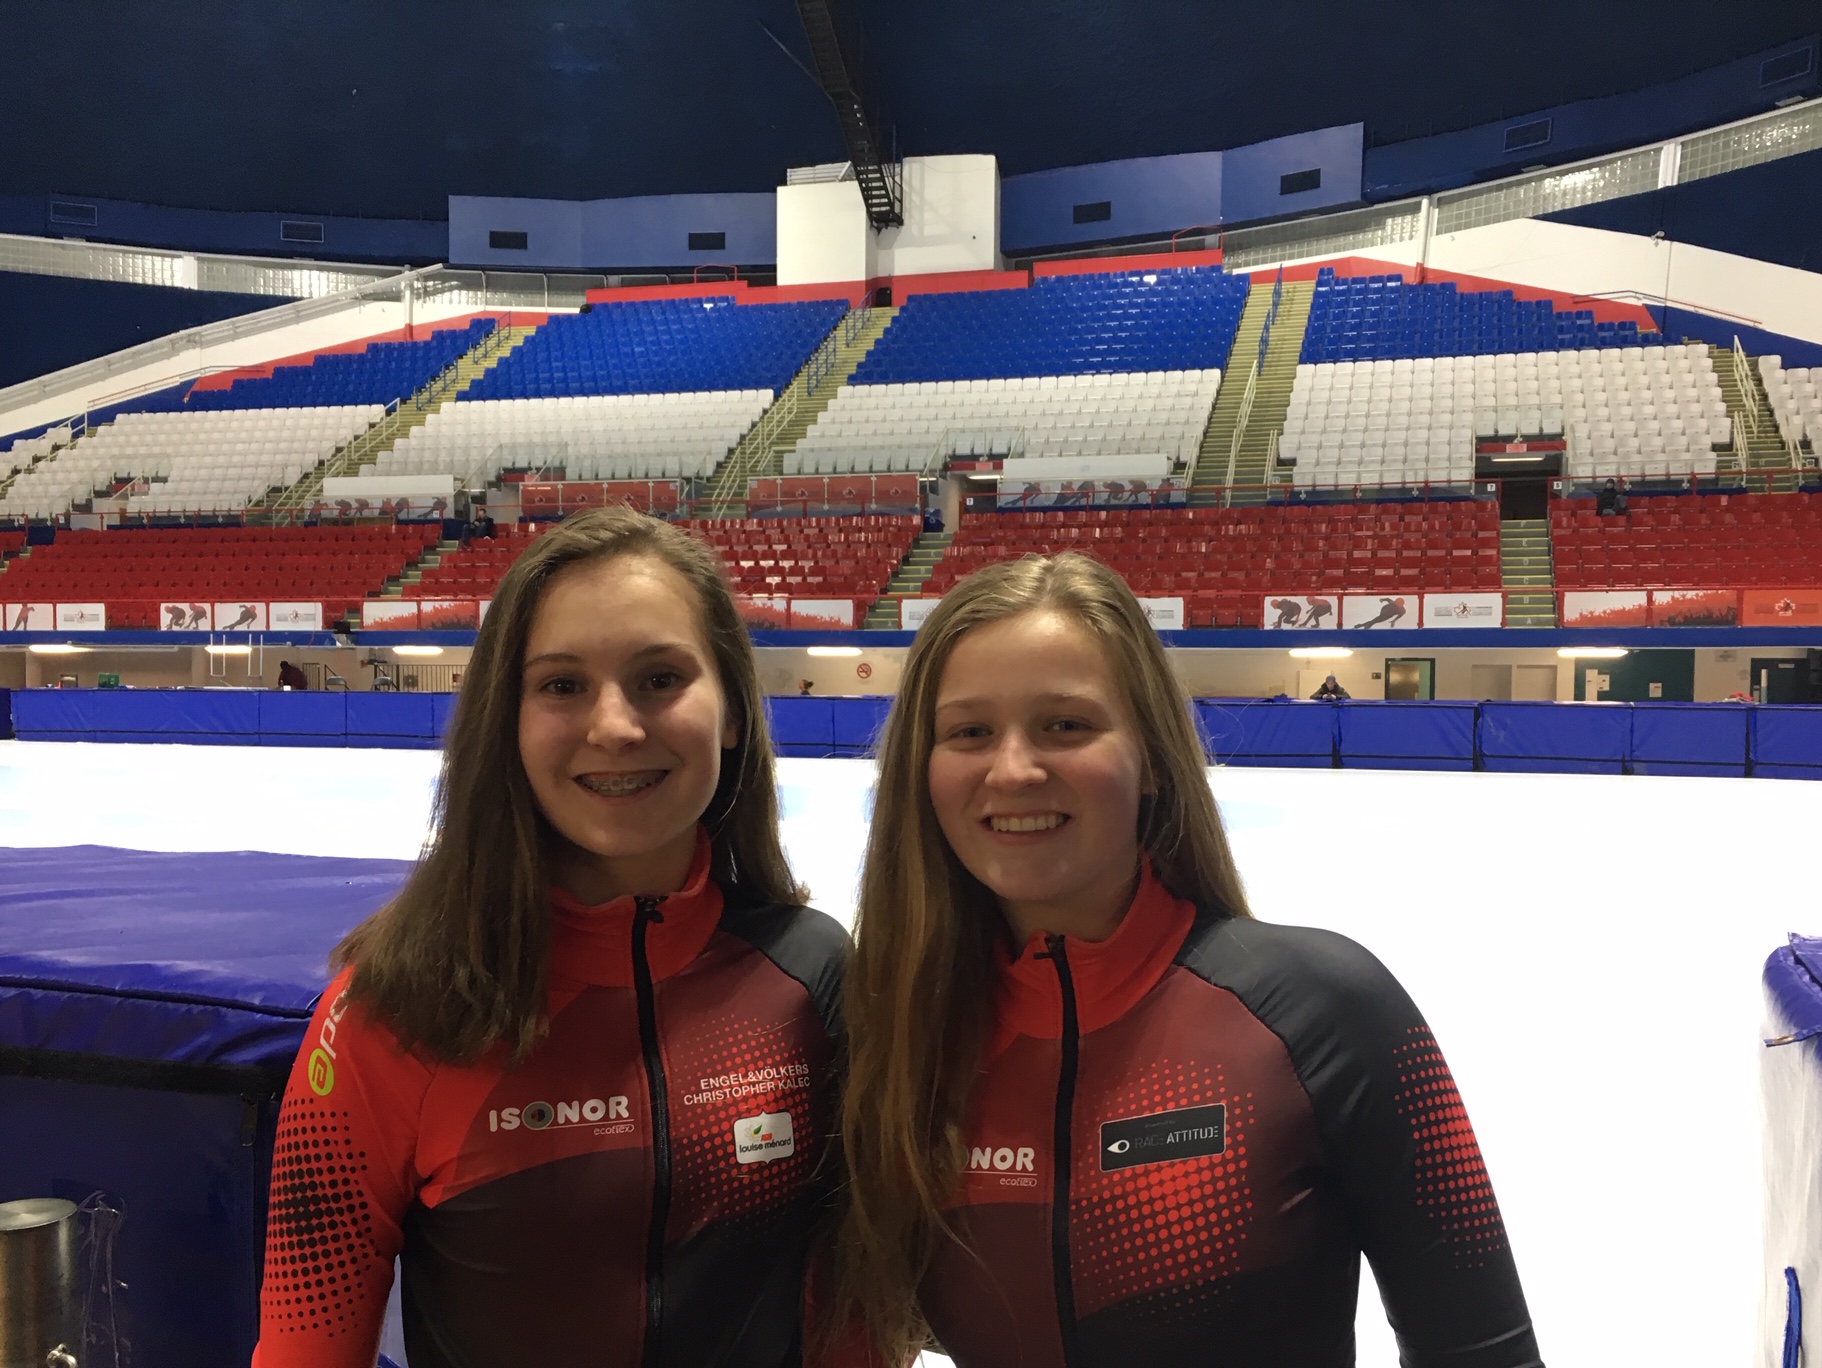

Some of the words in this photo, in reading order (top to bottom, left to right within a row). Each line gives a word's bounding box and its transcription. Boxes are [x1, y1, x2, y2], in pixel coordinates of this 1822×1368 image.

[683, 1081, 775, 1105] CHRISTOPHER
[778, 1076, 810, 1090] KALEC
[489, 1095, 629, 1132] ISONOR
[739, 1142, 763, 1153] louise
[764, 1136, 791, 1149] ménard
[1166, 1126, 1219, 1144] ATTITUDE
[960, 1146, 1035, 1172] NOR
